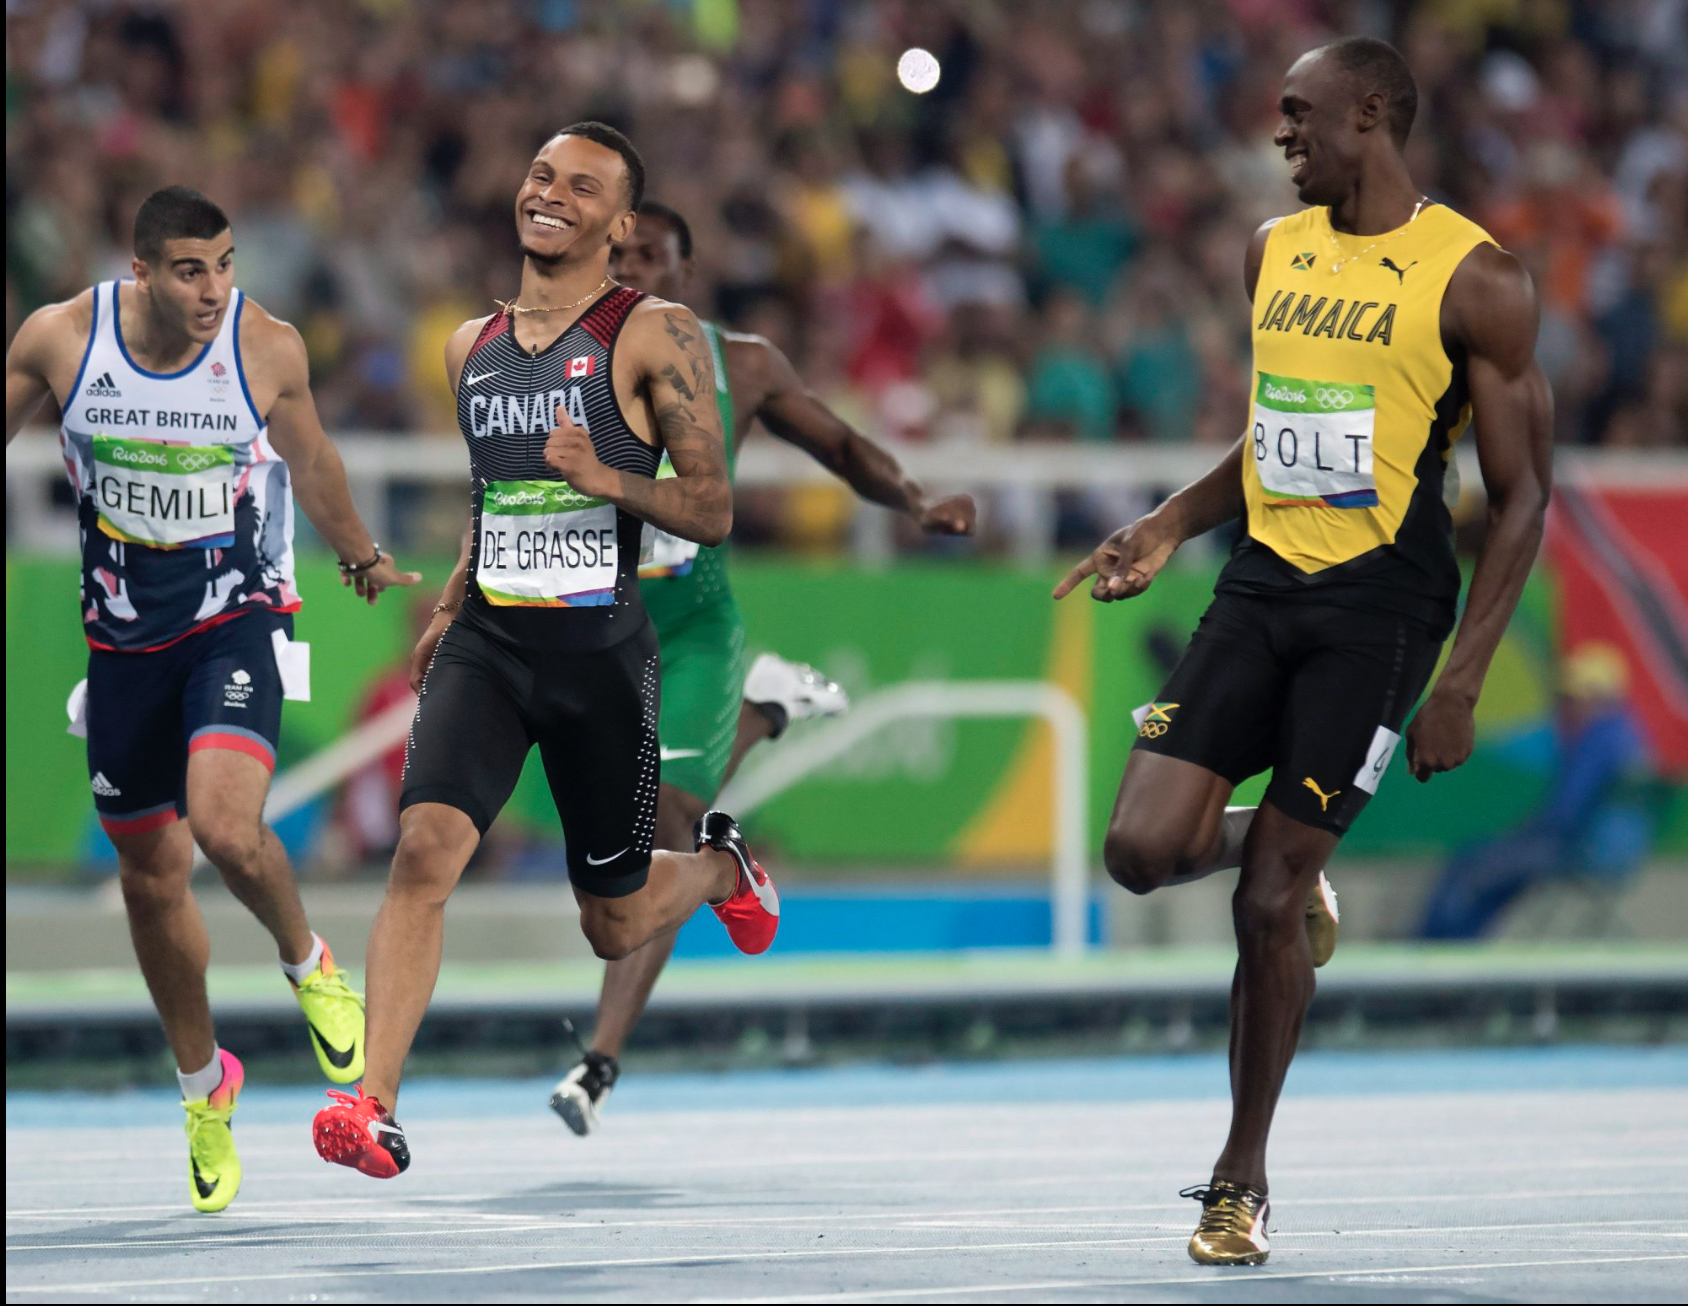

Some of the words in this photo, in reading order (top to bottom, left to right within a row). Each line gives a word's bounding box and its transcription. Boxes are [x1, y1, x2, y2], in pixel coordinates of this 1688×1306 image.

[1258, 290, 1397, 346] JAMAICA
[86, 387, 122, 398] adidas
[470, 386, 591, 438] CANADA
[85, 407, 150, 426] GREAT
[156, 411, 237, 431] BRITAIN
[113, 447, 168, 466] Rio2016
[1254, 422, 1368, 473] BOLT
[101, 476, 228, 520] GEMILI
[483, 530, 507, 569] DE
[517, 529, 613, 570] GRASSE
